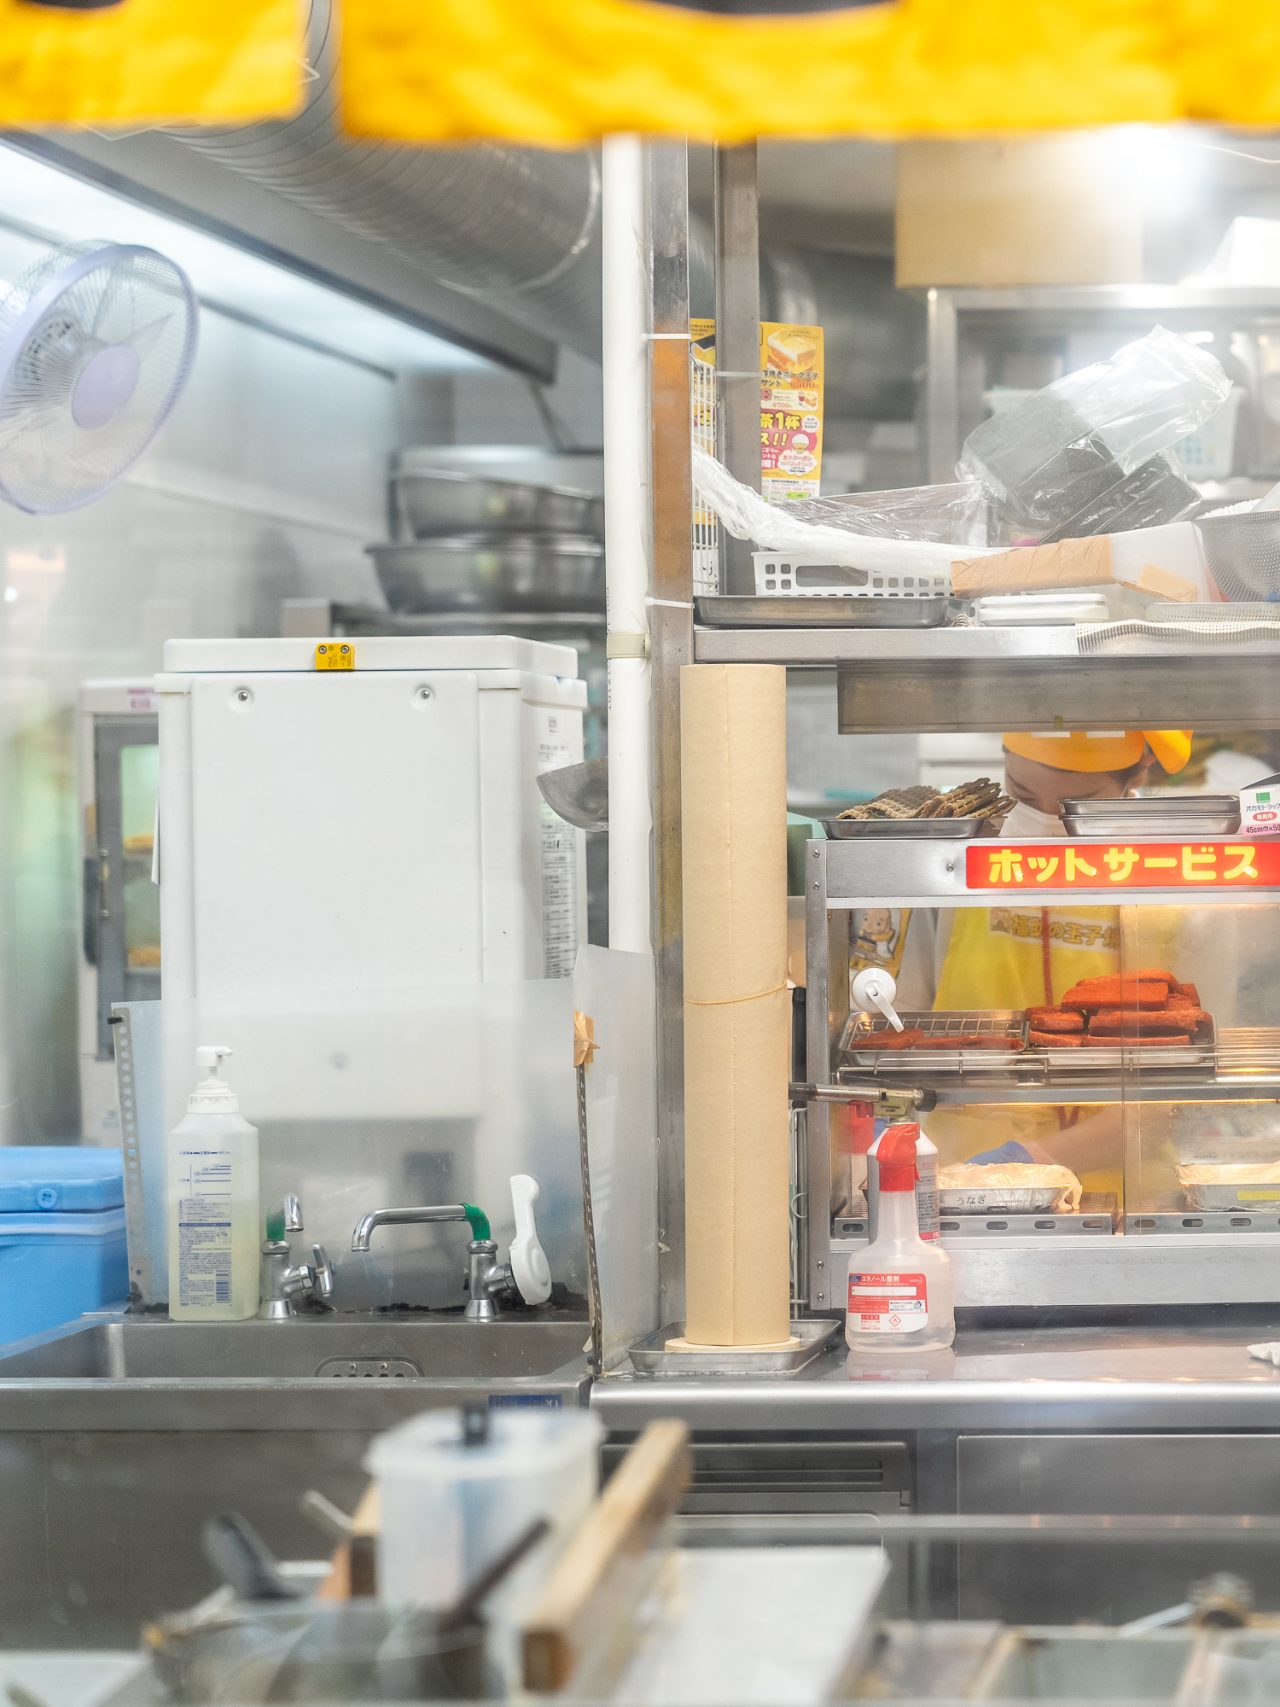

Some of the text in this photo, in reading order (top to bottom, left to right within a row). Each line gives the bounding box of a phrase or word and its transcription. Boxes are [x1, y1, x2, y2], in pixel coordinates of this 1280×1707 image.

[988, 846, 1259, 883] ホットサービス
[957, 1194, 987, 1206] うなぎ
